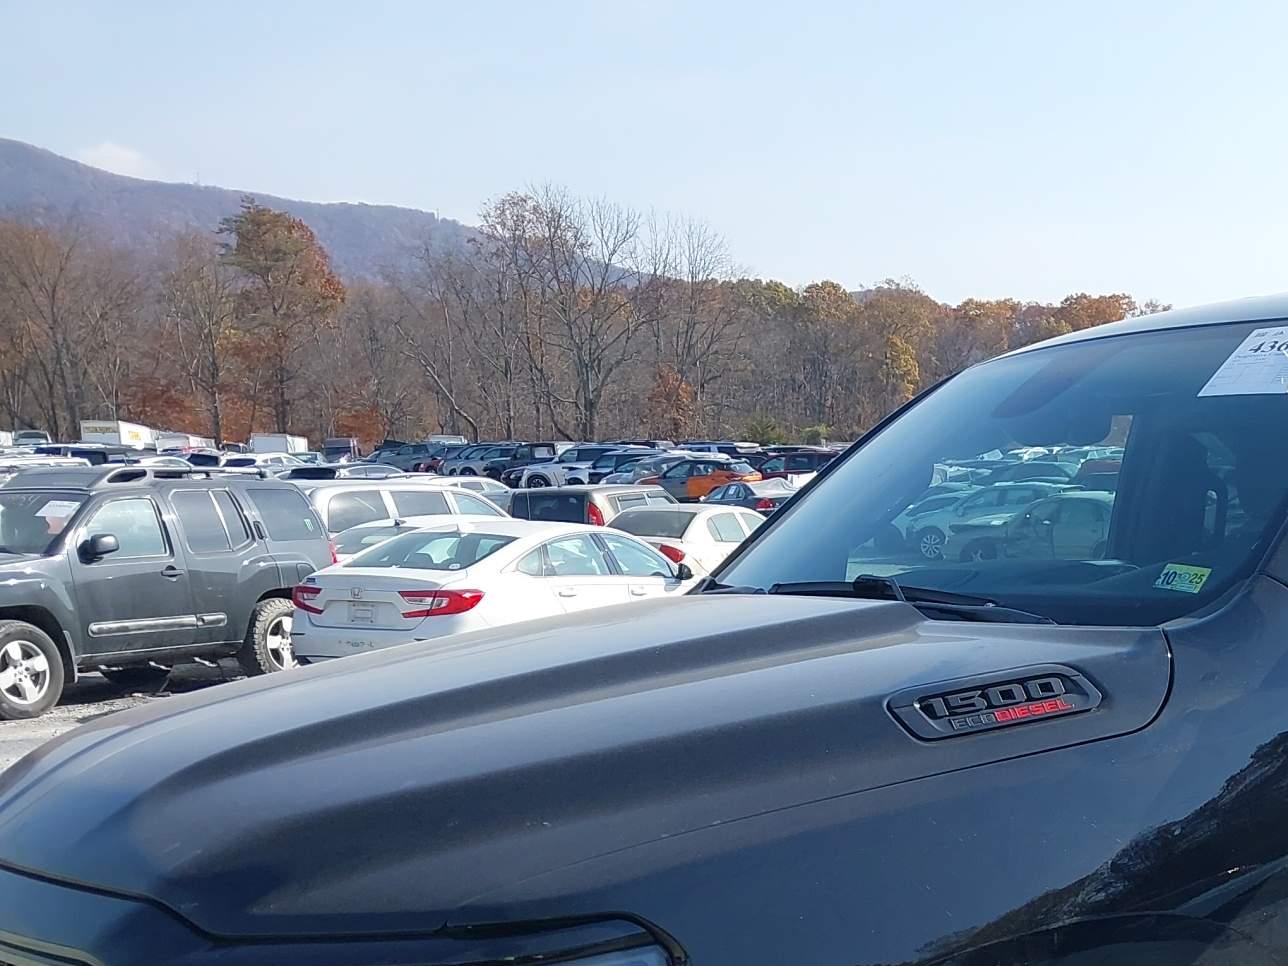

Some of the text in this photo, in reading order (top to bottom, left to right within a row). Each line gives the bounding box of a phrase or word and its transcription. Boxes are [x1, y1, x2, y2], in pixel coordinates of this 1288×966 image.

[1161, 571, 1205, 585] 10 25
[925, 676, 1066, 718] 1500
[950, 698, 1075, 730] ECODIESEL
